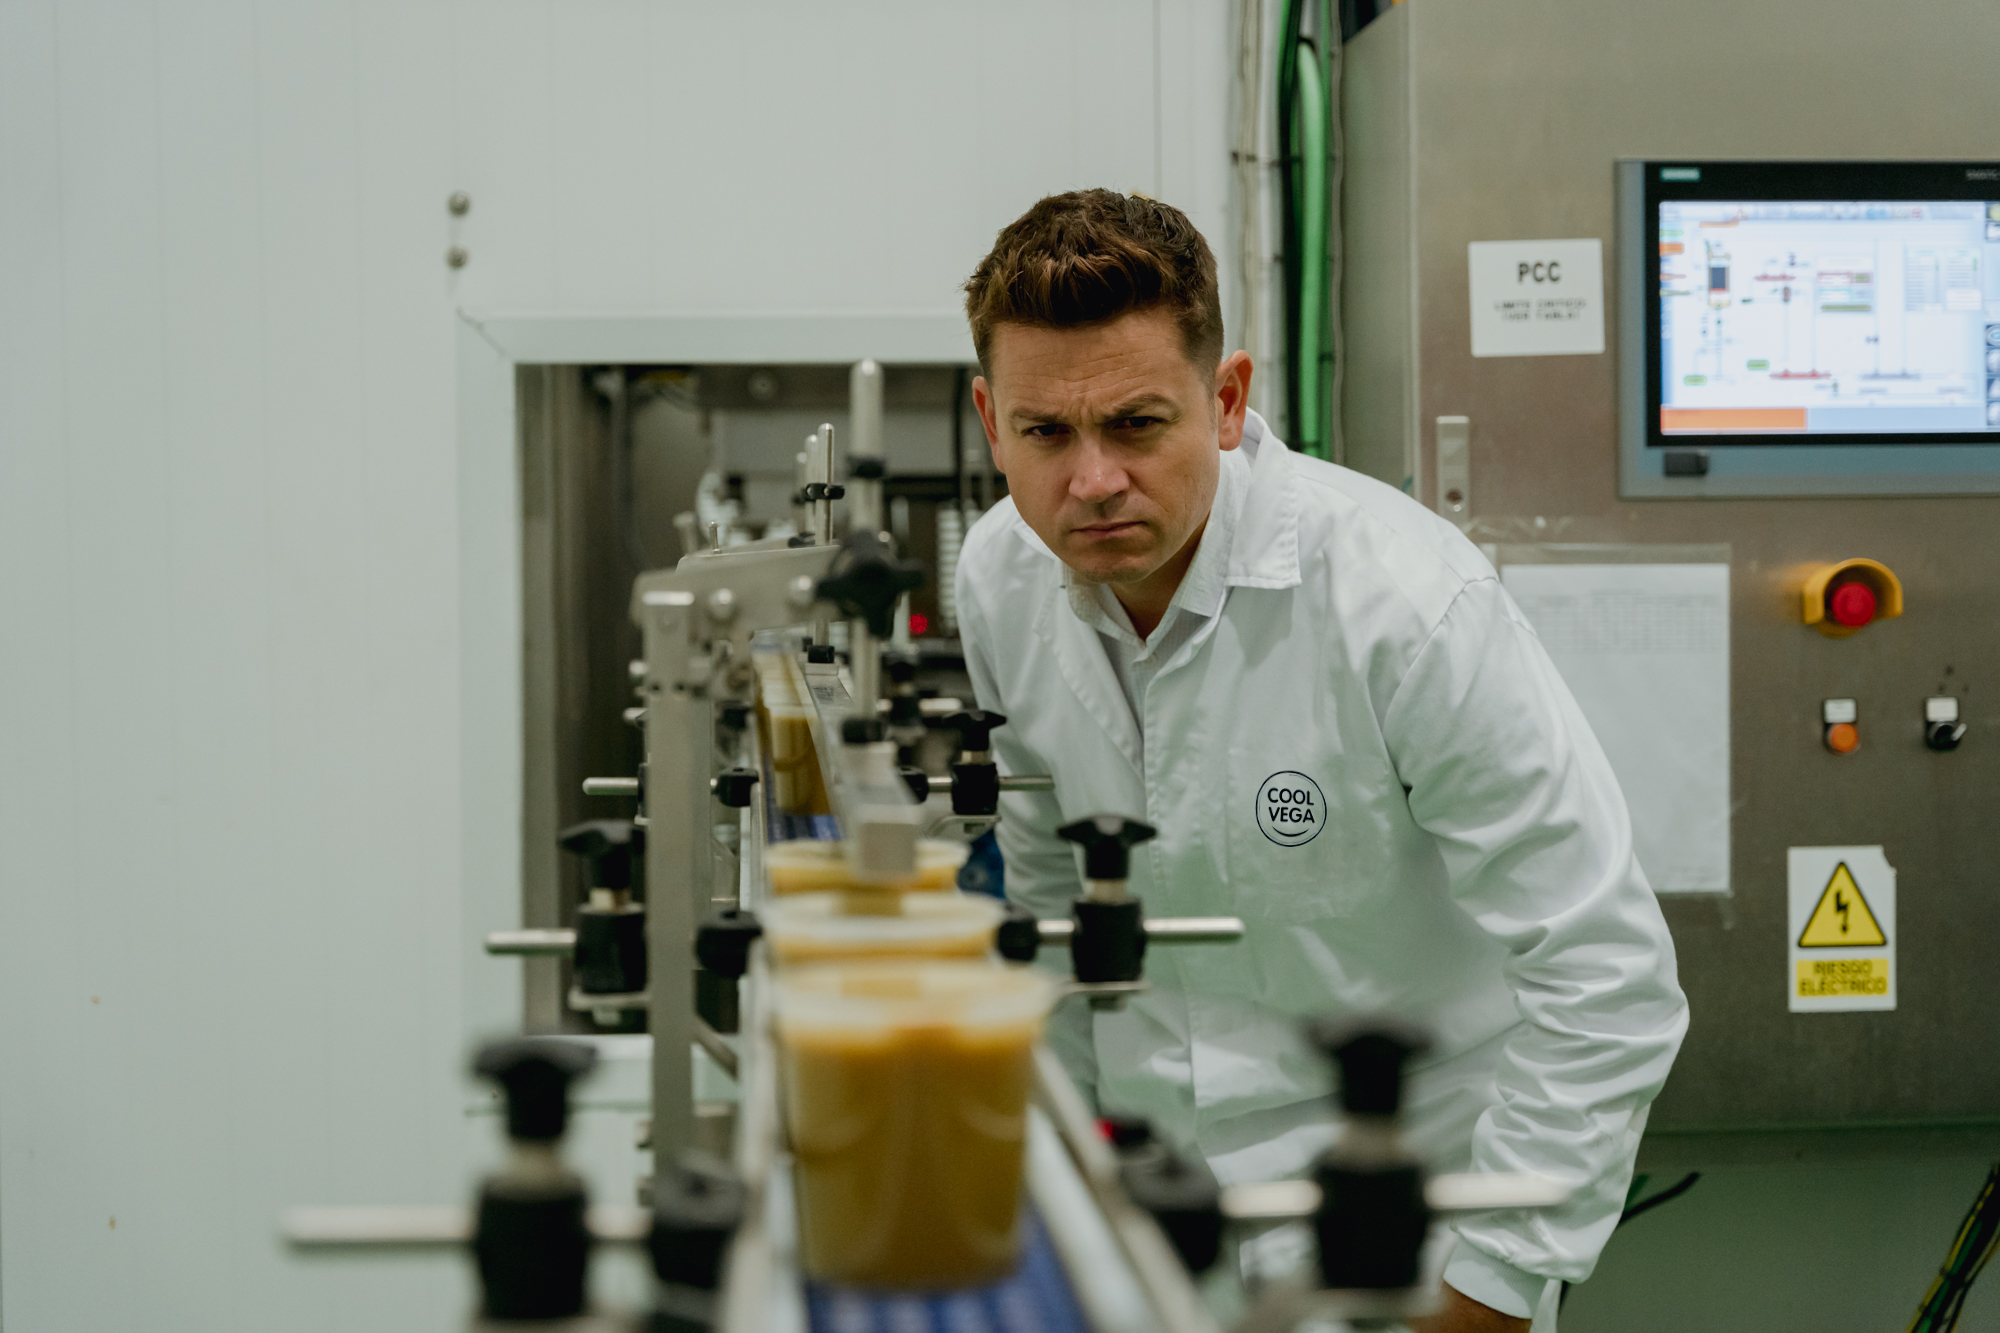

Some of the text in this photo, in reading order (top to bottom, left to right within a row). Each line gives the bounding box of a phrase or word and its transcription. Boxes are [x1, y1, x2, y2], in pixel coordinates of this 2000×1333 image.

[1518, 262, 1560, 282] PCC
[1268, 787, 1314, 806] COOL
[1268, 806, 1315, 824] VEGA
[1814, 960, 1872, 975] RIESGO
